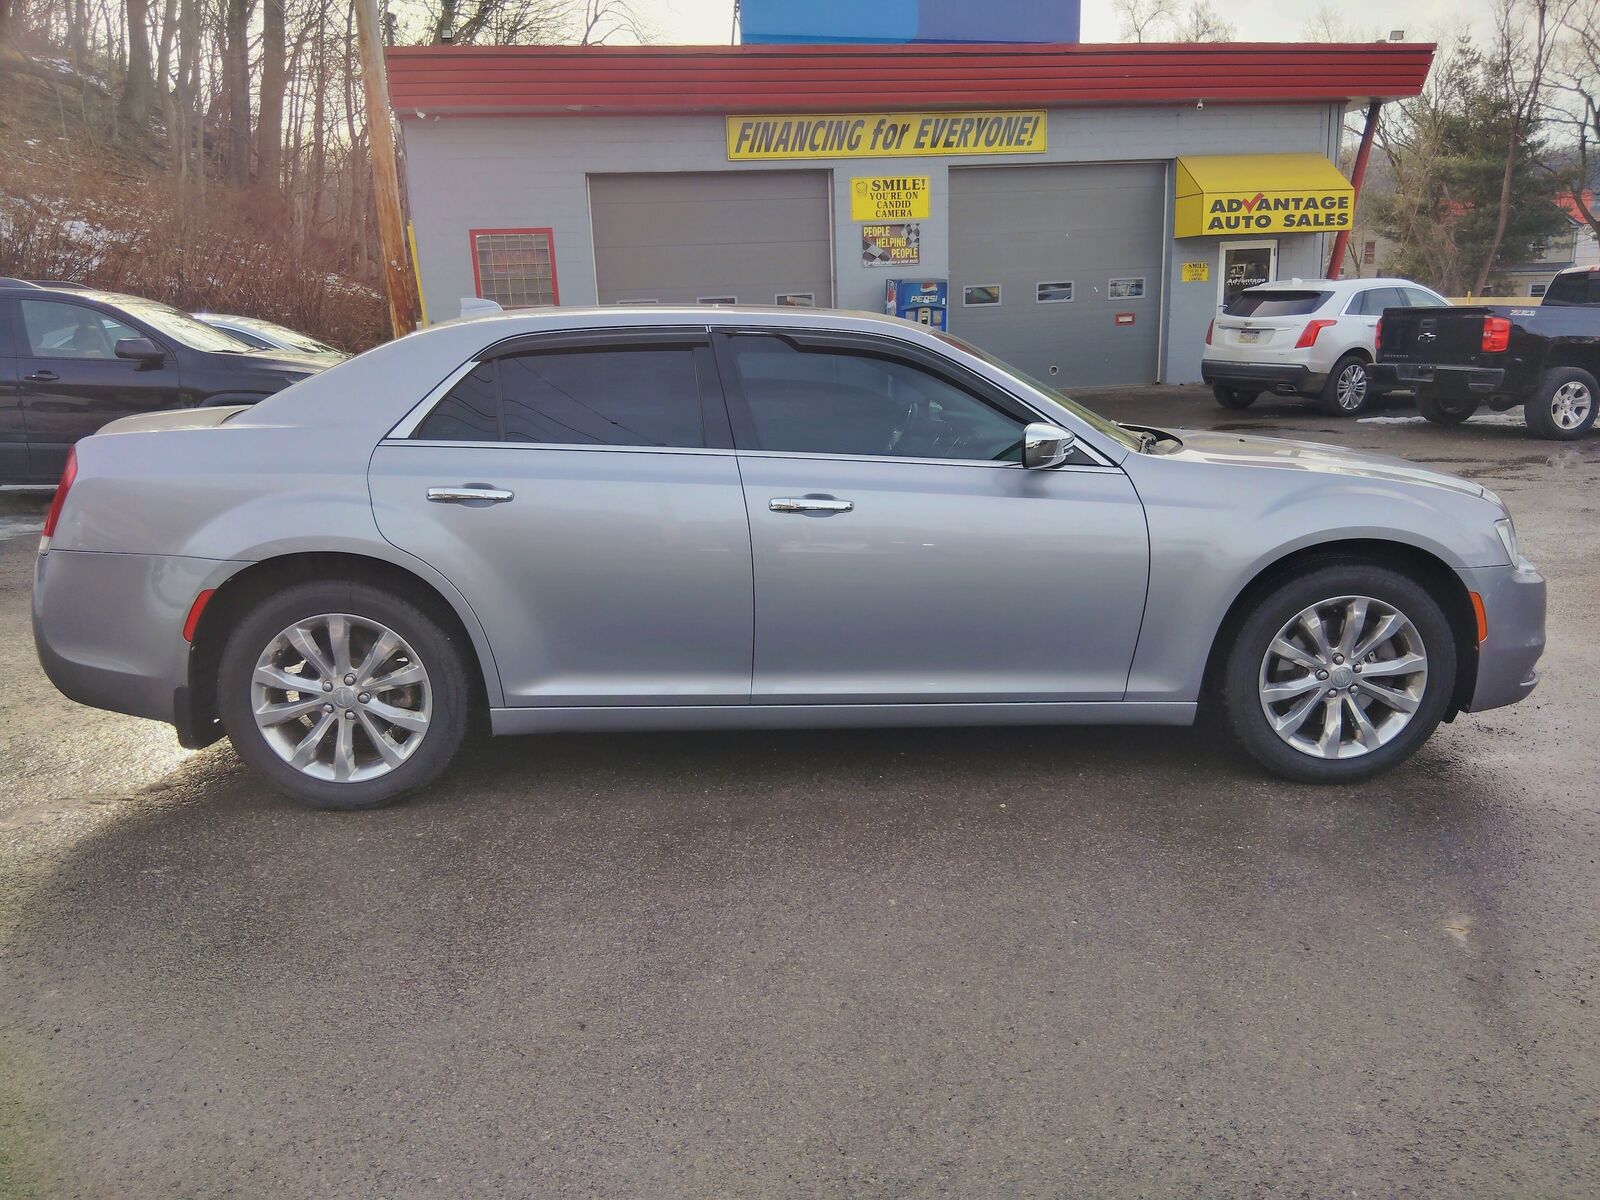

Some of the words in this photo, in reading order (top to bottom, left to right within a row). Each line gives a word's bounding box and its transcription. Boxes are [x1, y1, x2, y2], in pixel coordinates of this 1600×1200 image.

[734, 119, 865, 153] FINANCING
[870, 118, 911, 151] for
[913, 116, 1040, 149] EVERYONE!
[871, 178, 926, 192] SMILE!
[869, 191, 902, 200] YOU'RE
[905, 191, 919, 200] ON
[876, 200, 911, 209] CANDID
[1209, 192, 1349, 214] ADVANTAGE
[875, 209, 912, 218] CAMERA
[1207, 214, 1272, 230] AUTO
[1282, 212, 1349, 227] SALES
[863, 226, 890, 238] PEOPLE
[876, 237, 906, 248] HELPING
[891, 247, 918, 259] PEOPLE
